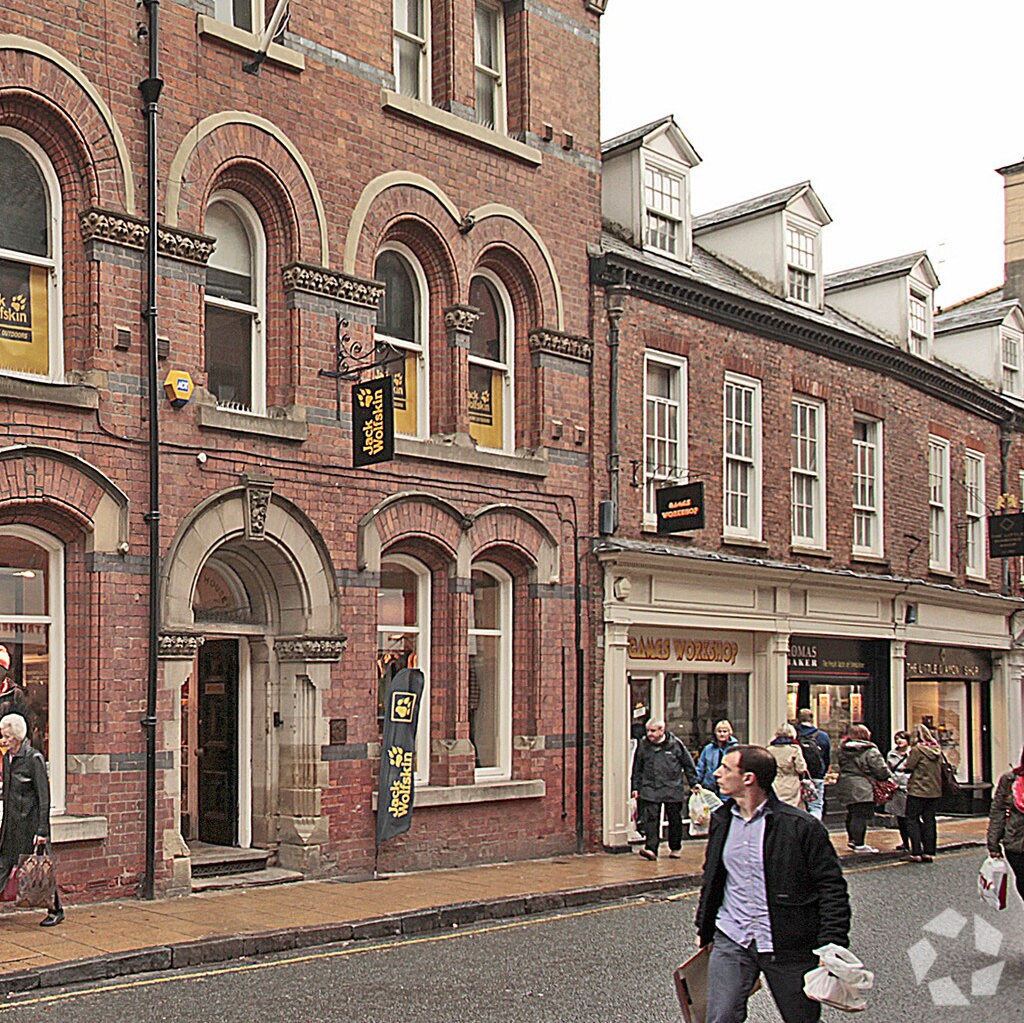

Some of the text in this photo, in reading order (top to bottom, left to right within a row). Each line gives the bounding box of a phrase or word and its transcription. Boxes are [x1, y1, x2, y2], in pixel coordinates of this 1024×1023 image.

[1, 329, 28, 339] OUTDOORS
[363, 419, 374, 456] Jack
[372, 388, 384, 455] Wolfskin
[661, 506, 701, 519] WORKSHOP
[628, 635, 738, 665] GAMES WORKSHOP
[789, 645, 817, 657] OMAS
[388, 780, 401, 818] Jack
[397, 752, 413, 818] Wolfskin
